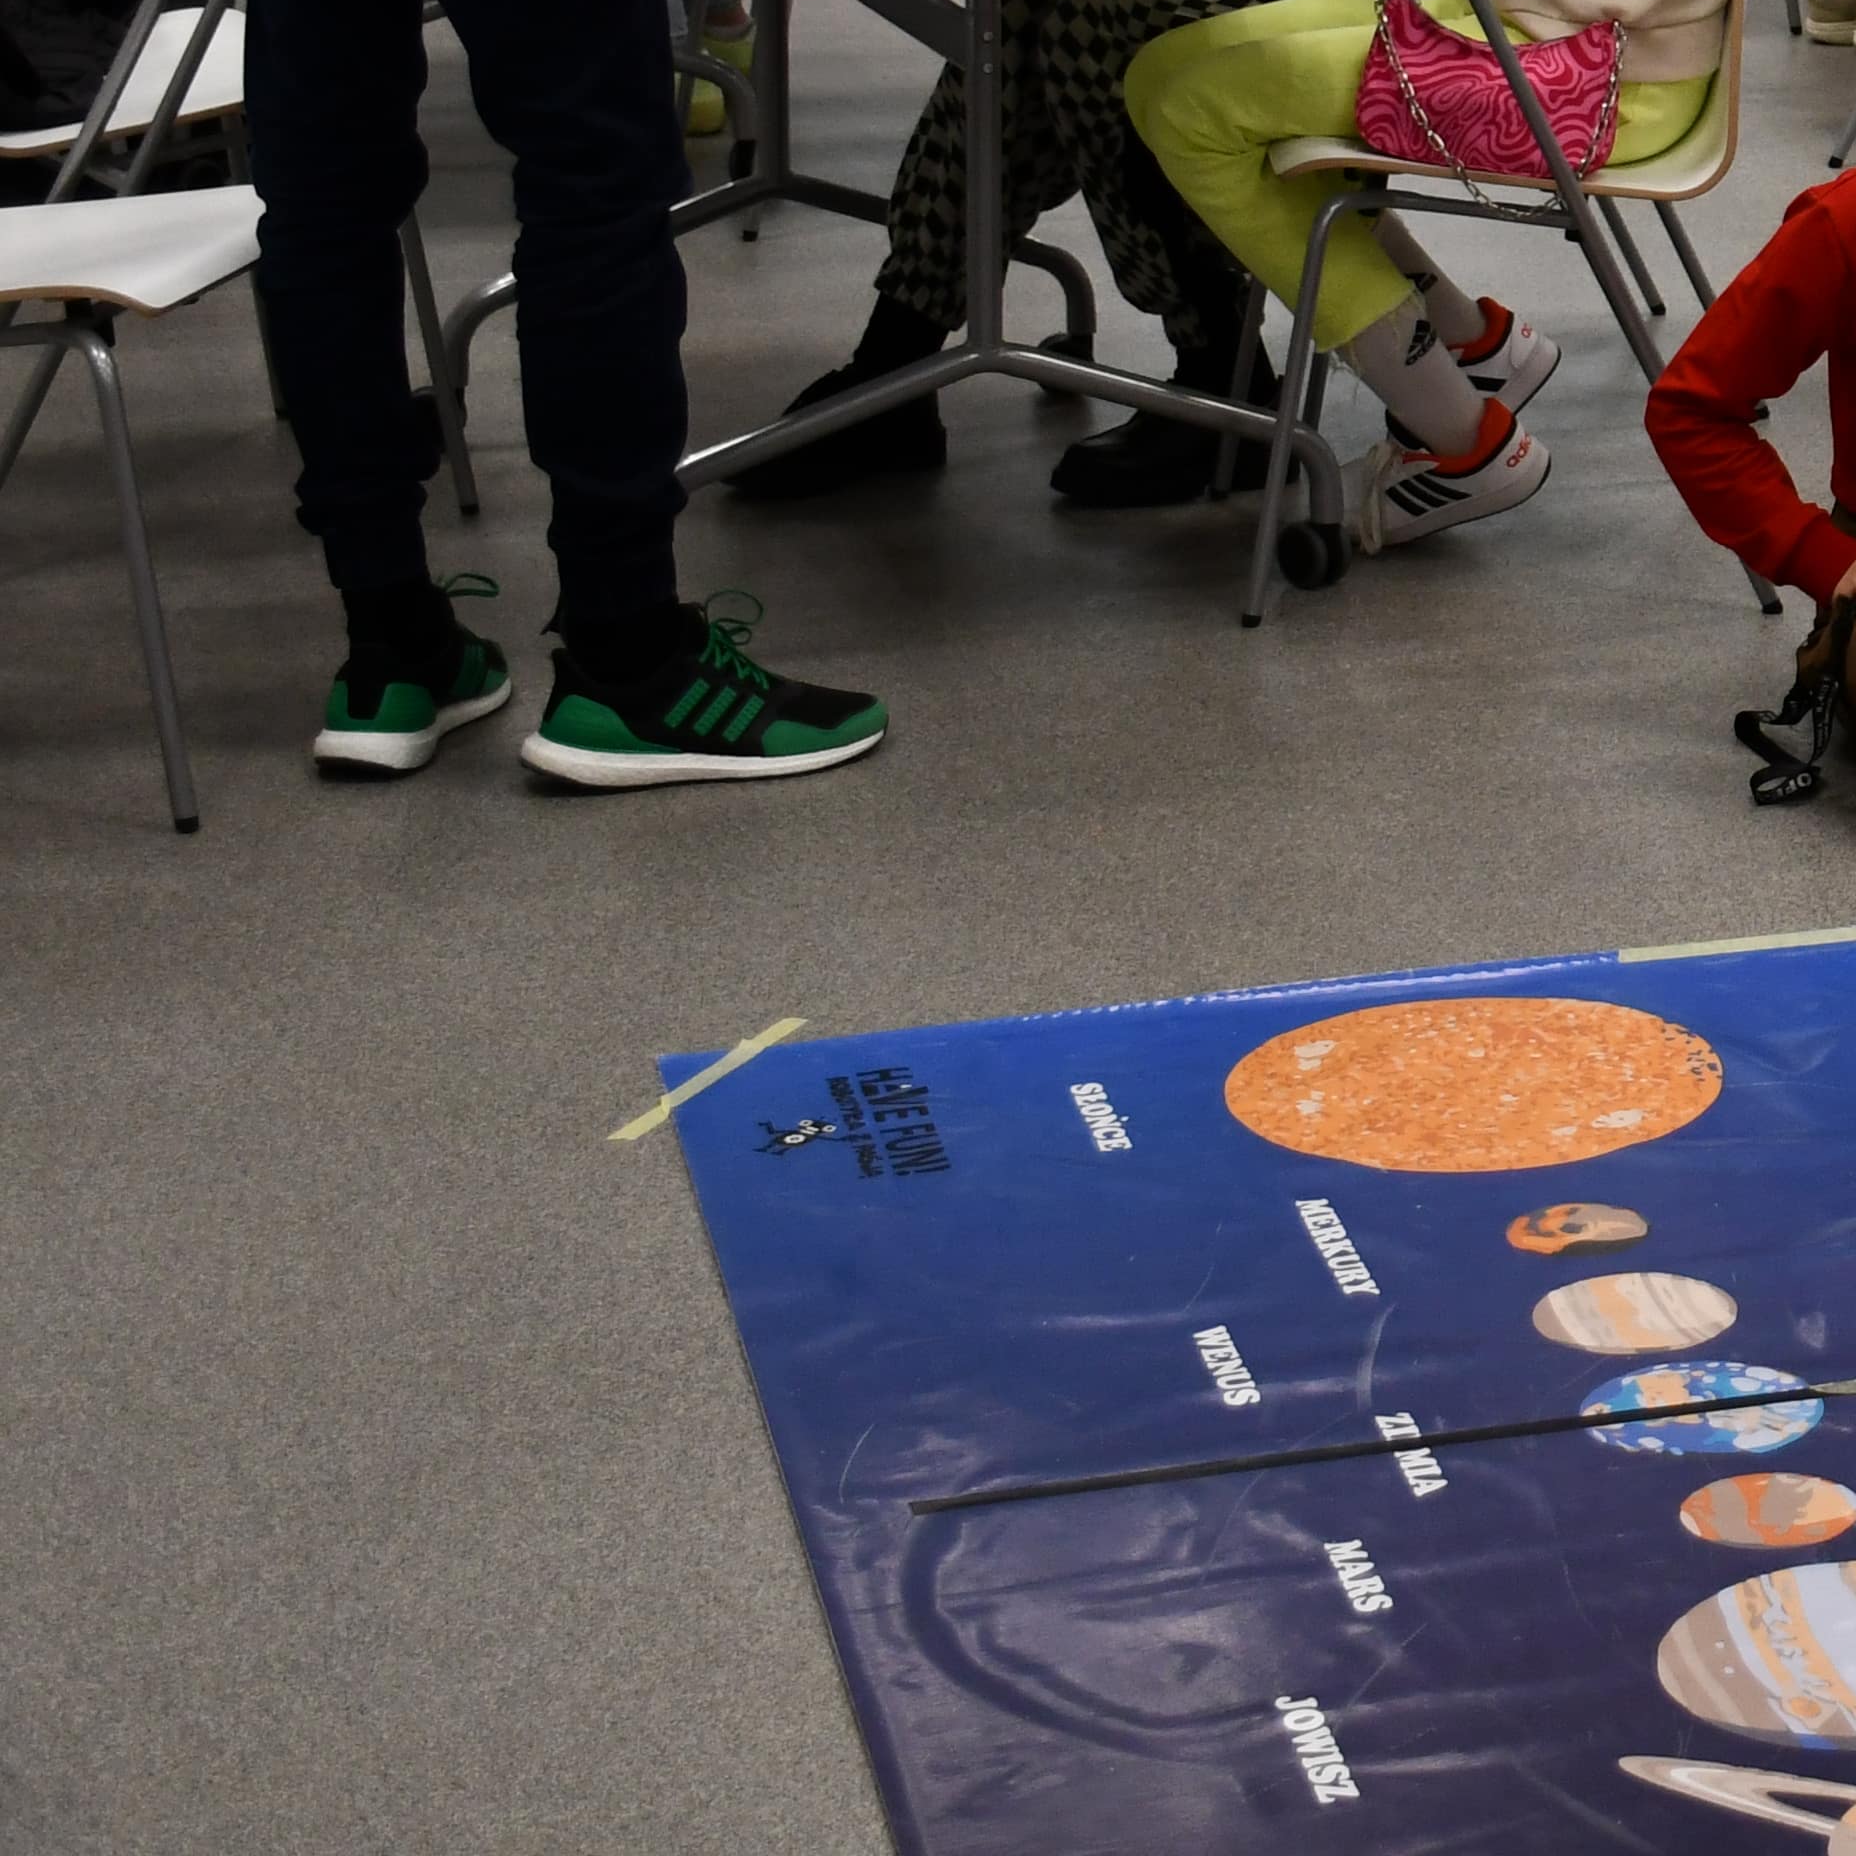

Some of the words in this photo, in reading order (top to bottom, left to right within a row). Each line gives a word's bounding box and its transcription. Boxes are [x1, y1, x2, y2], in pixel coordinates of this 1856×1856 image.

[856, 1065, 933, 1123] HAVE
[880, 1120, 951, 1177] FUN!
[1295, 1197, 1380, 1298] MERKURY
[1191, 1324, 1262, 1408] WENUS
[1374, 1411, 1449, 1498] ZIMIA
[1323, 1539, 1394, 1614] MARS
[1274, 1694, 1361, 1806] JOWISZ
